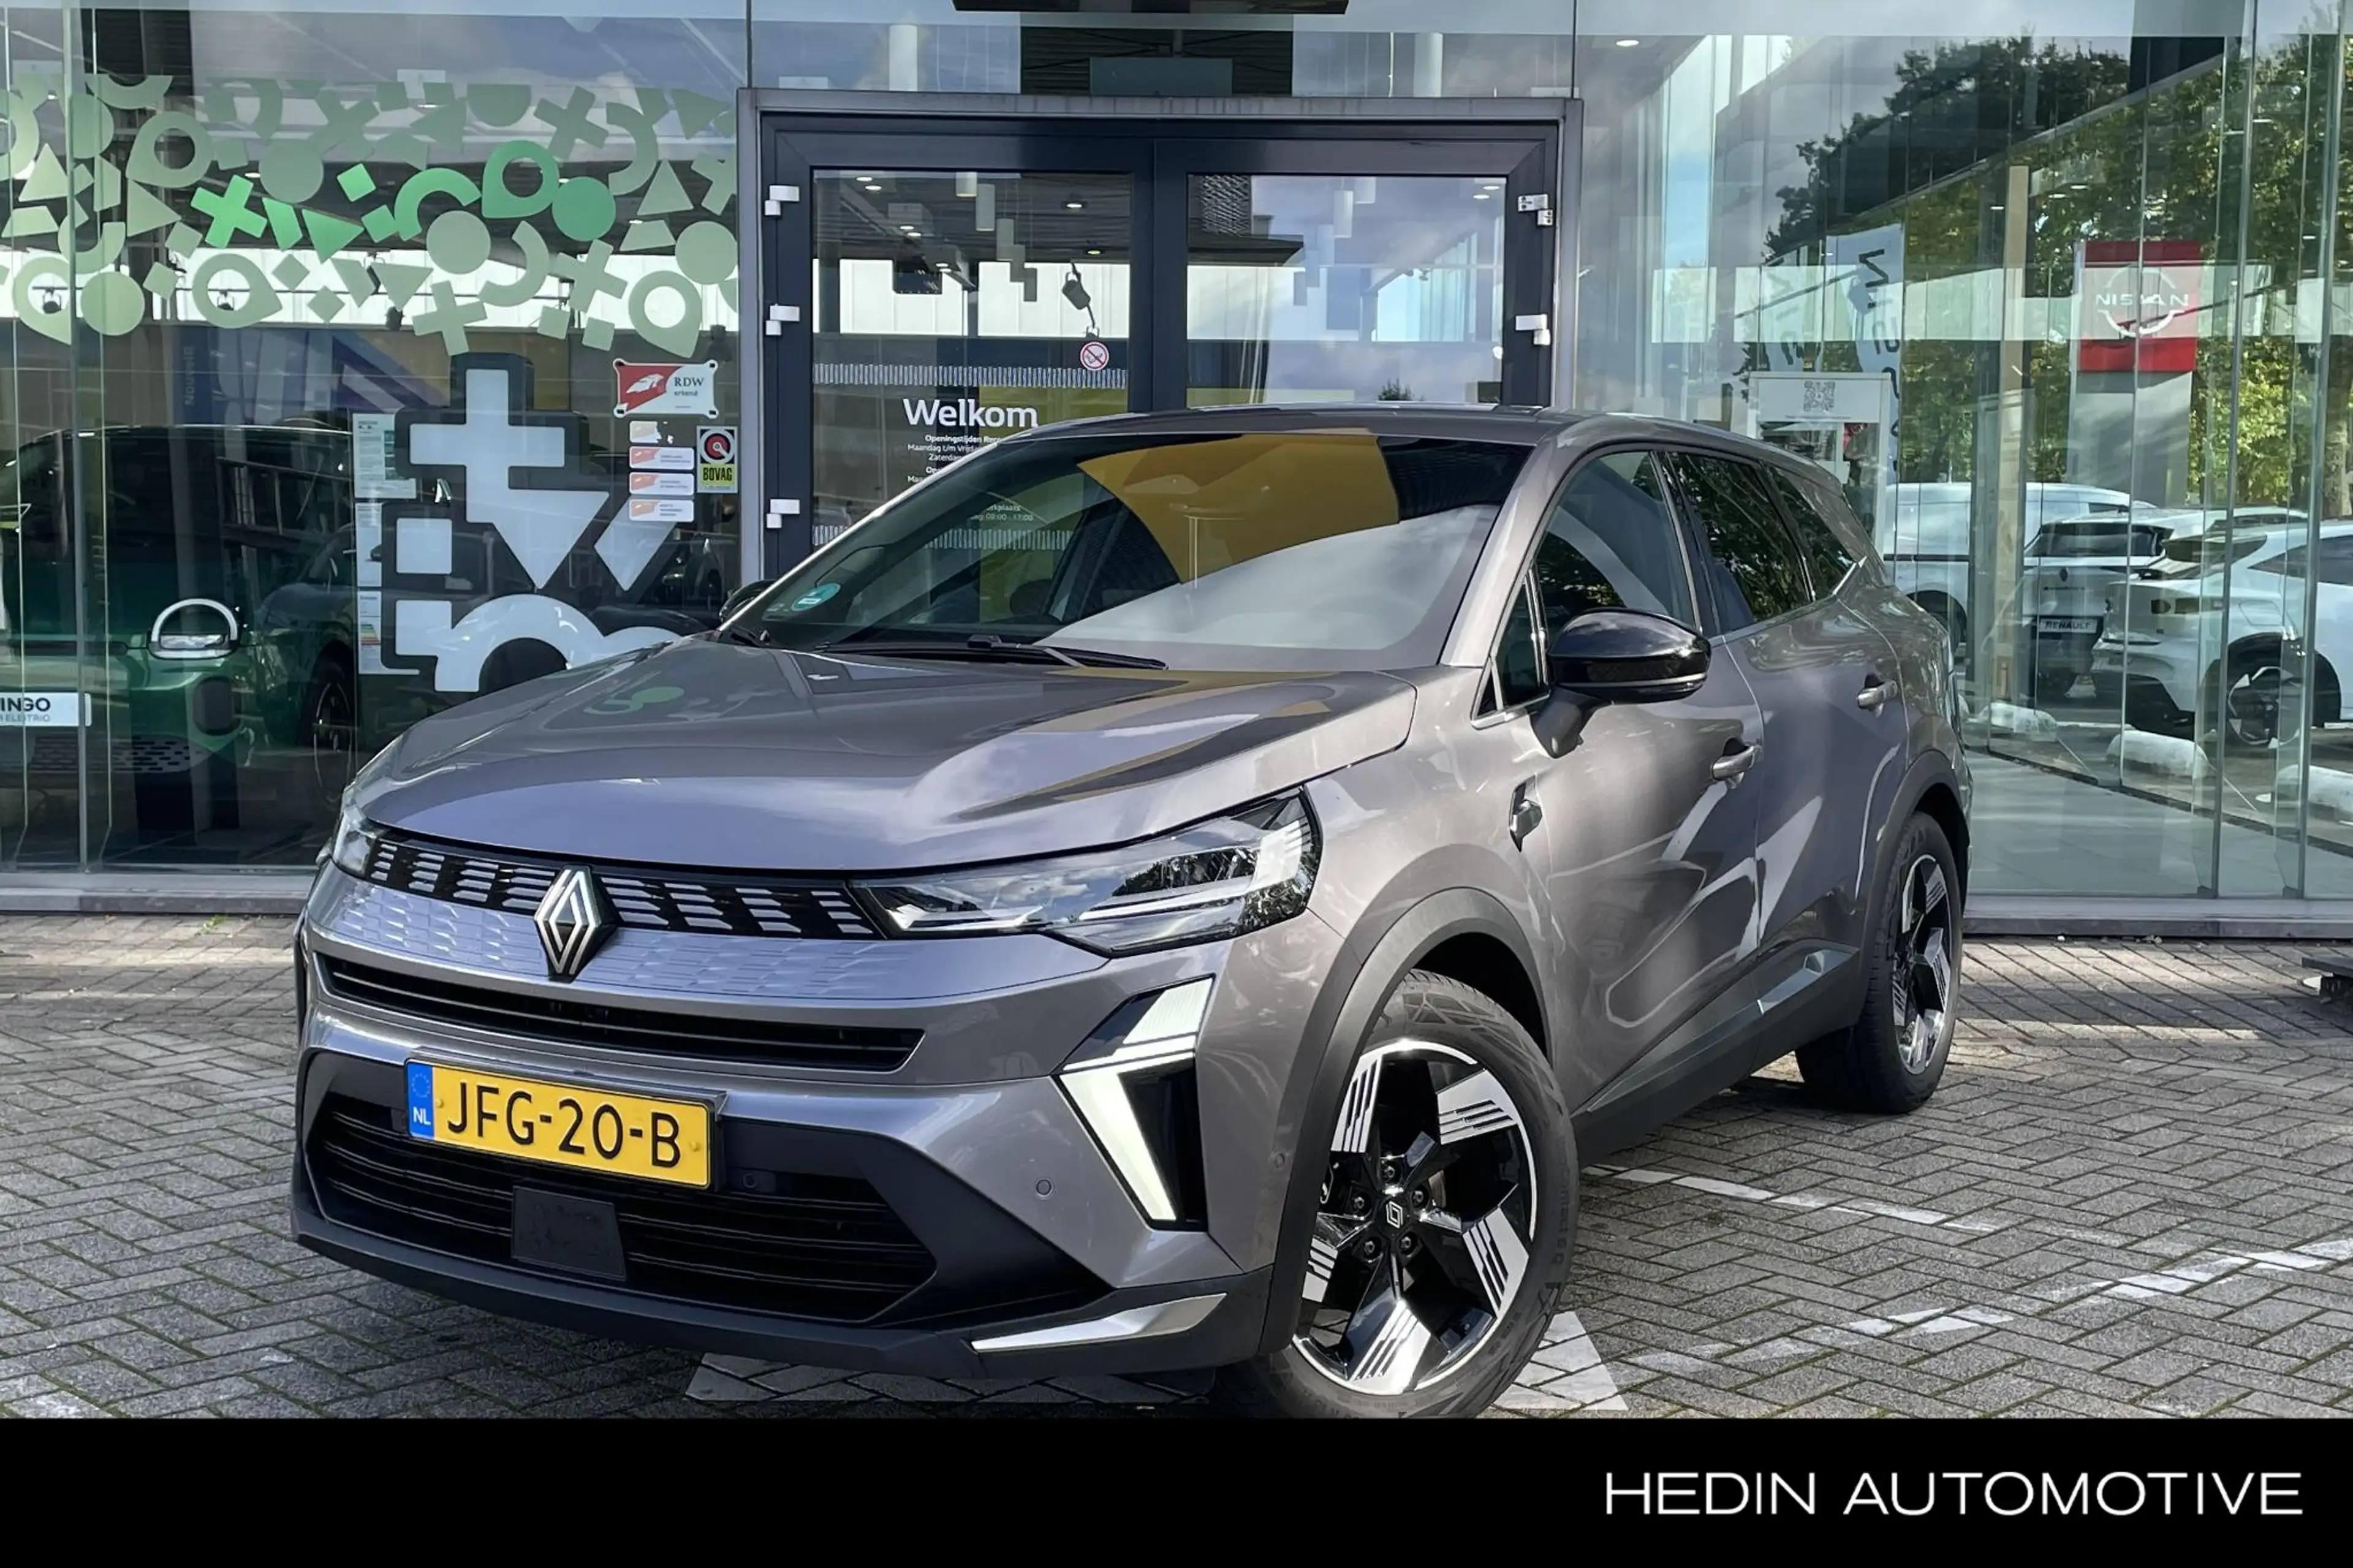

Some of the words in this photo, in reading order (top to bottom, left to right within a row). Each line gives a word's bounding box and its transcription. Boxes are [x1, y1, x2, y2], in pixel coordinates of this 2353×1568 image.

[674, 377, 704, 387] RDW
[902, 398, 1039, 428] Welkom
[925, 434, 982, 444] Openingstijden
[907, 444, 941, 453] Maandag
[703, 468, 733, 482] BOVAG
[412, 1106, 432, 1126] NL
[447, 1081, 681, 1168] JFG-20-B
